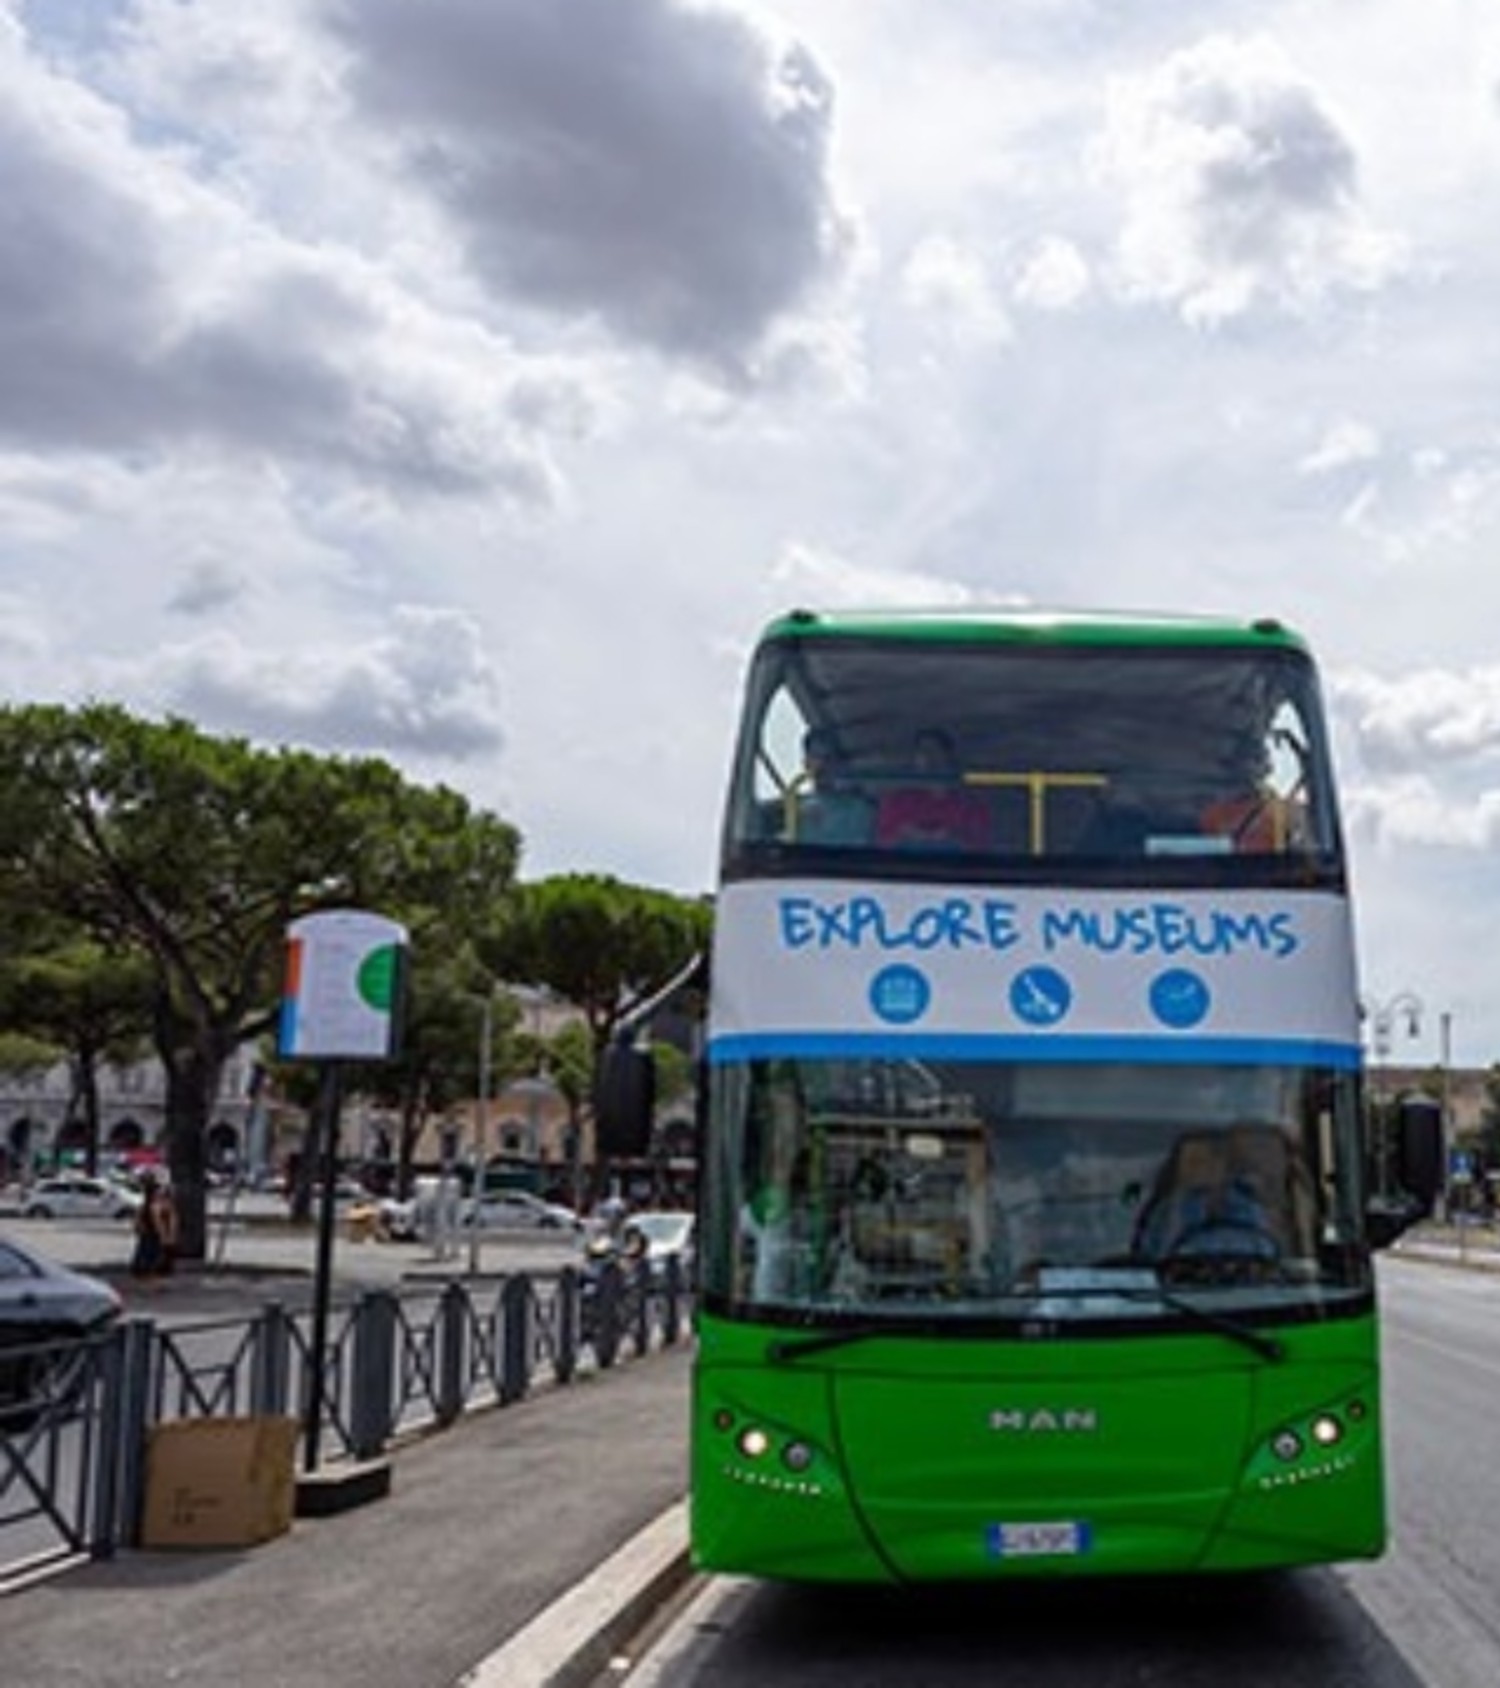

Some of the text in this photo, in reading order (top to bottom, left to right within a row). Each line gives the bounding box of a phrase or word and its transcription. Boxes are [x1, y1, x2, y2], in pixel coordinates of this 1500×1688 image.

[779, 897, 1298, 957] EXPLORE MUSEUMS
[989, 1409, 1098, 1432] MAN
